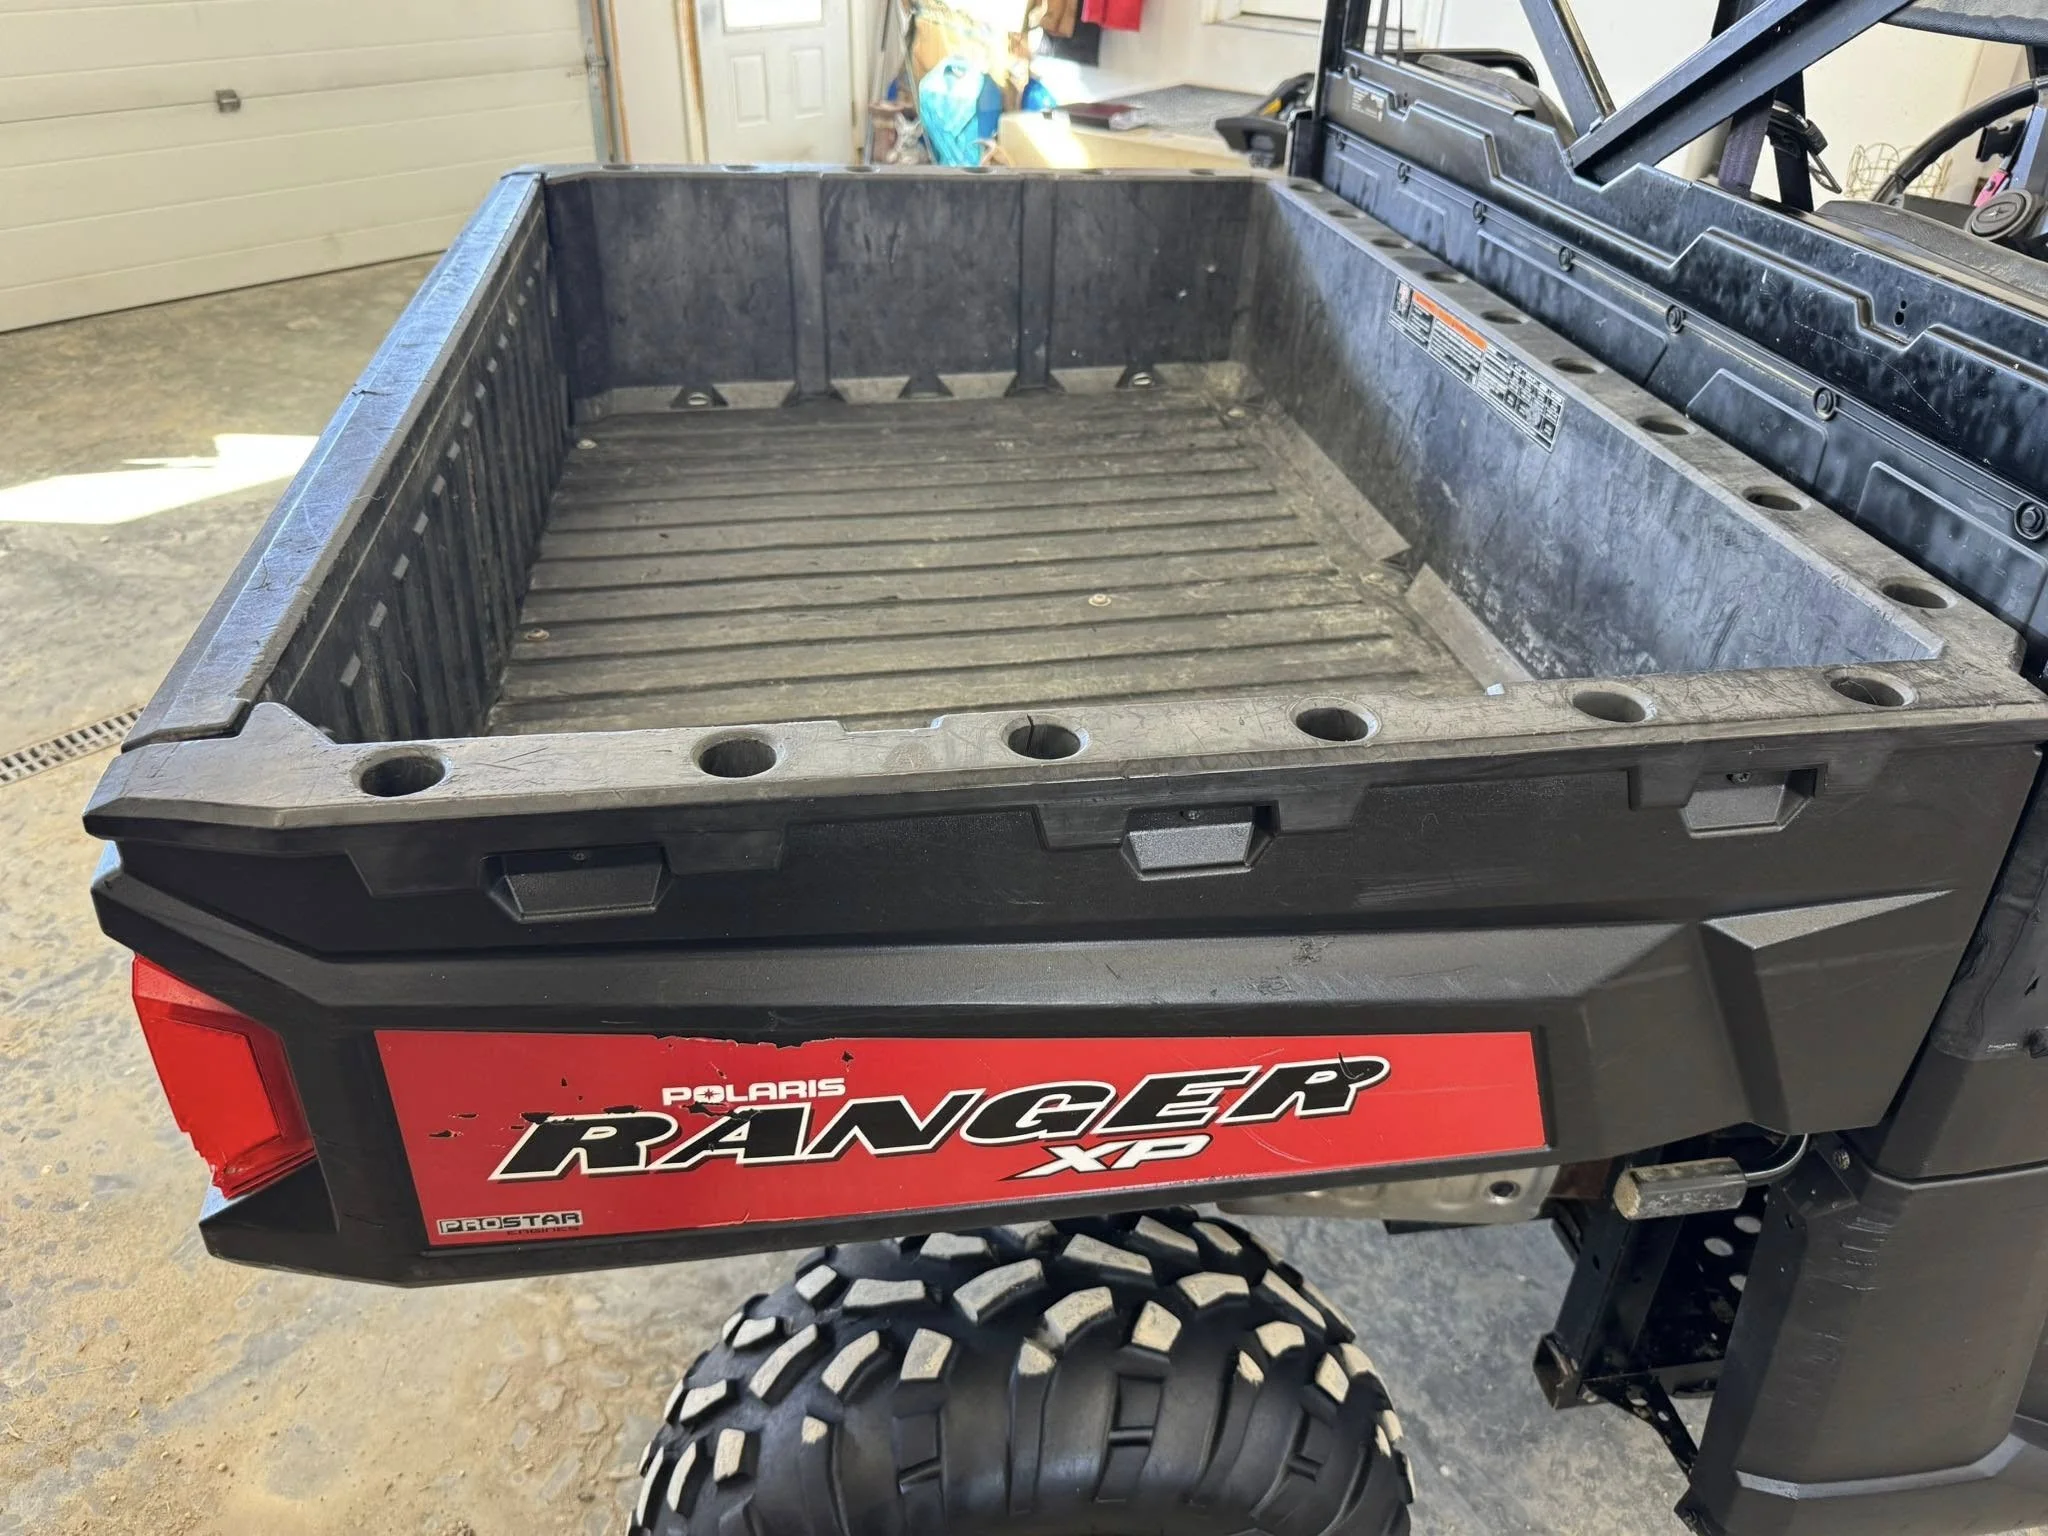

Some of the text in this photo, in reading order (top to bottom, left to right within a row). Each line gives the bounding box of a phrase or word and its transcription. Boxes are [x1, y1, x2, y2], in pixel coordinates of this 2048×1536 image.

[662, 1077, 845, 1106] POLARIS
[487, 1055, 1391, 1182] RANGER
[1000, 1134, 1213, 1181] XP
[439, 1212, 581, 1234] PROSTAR
